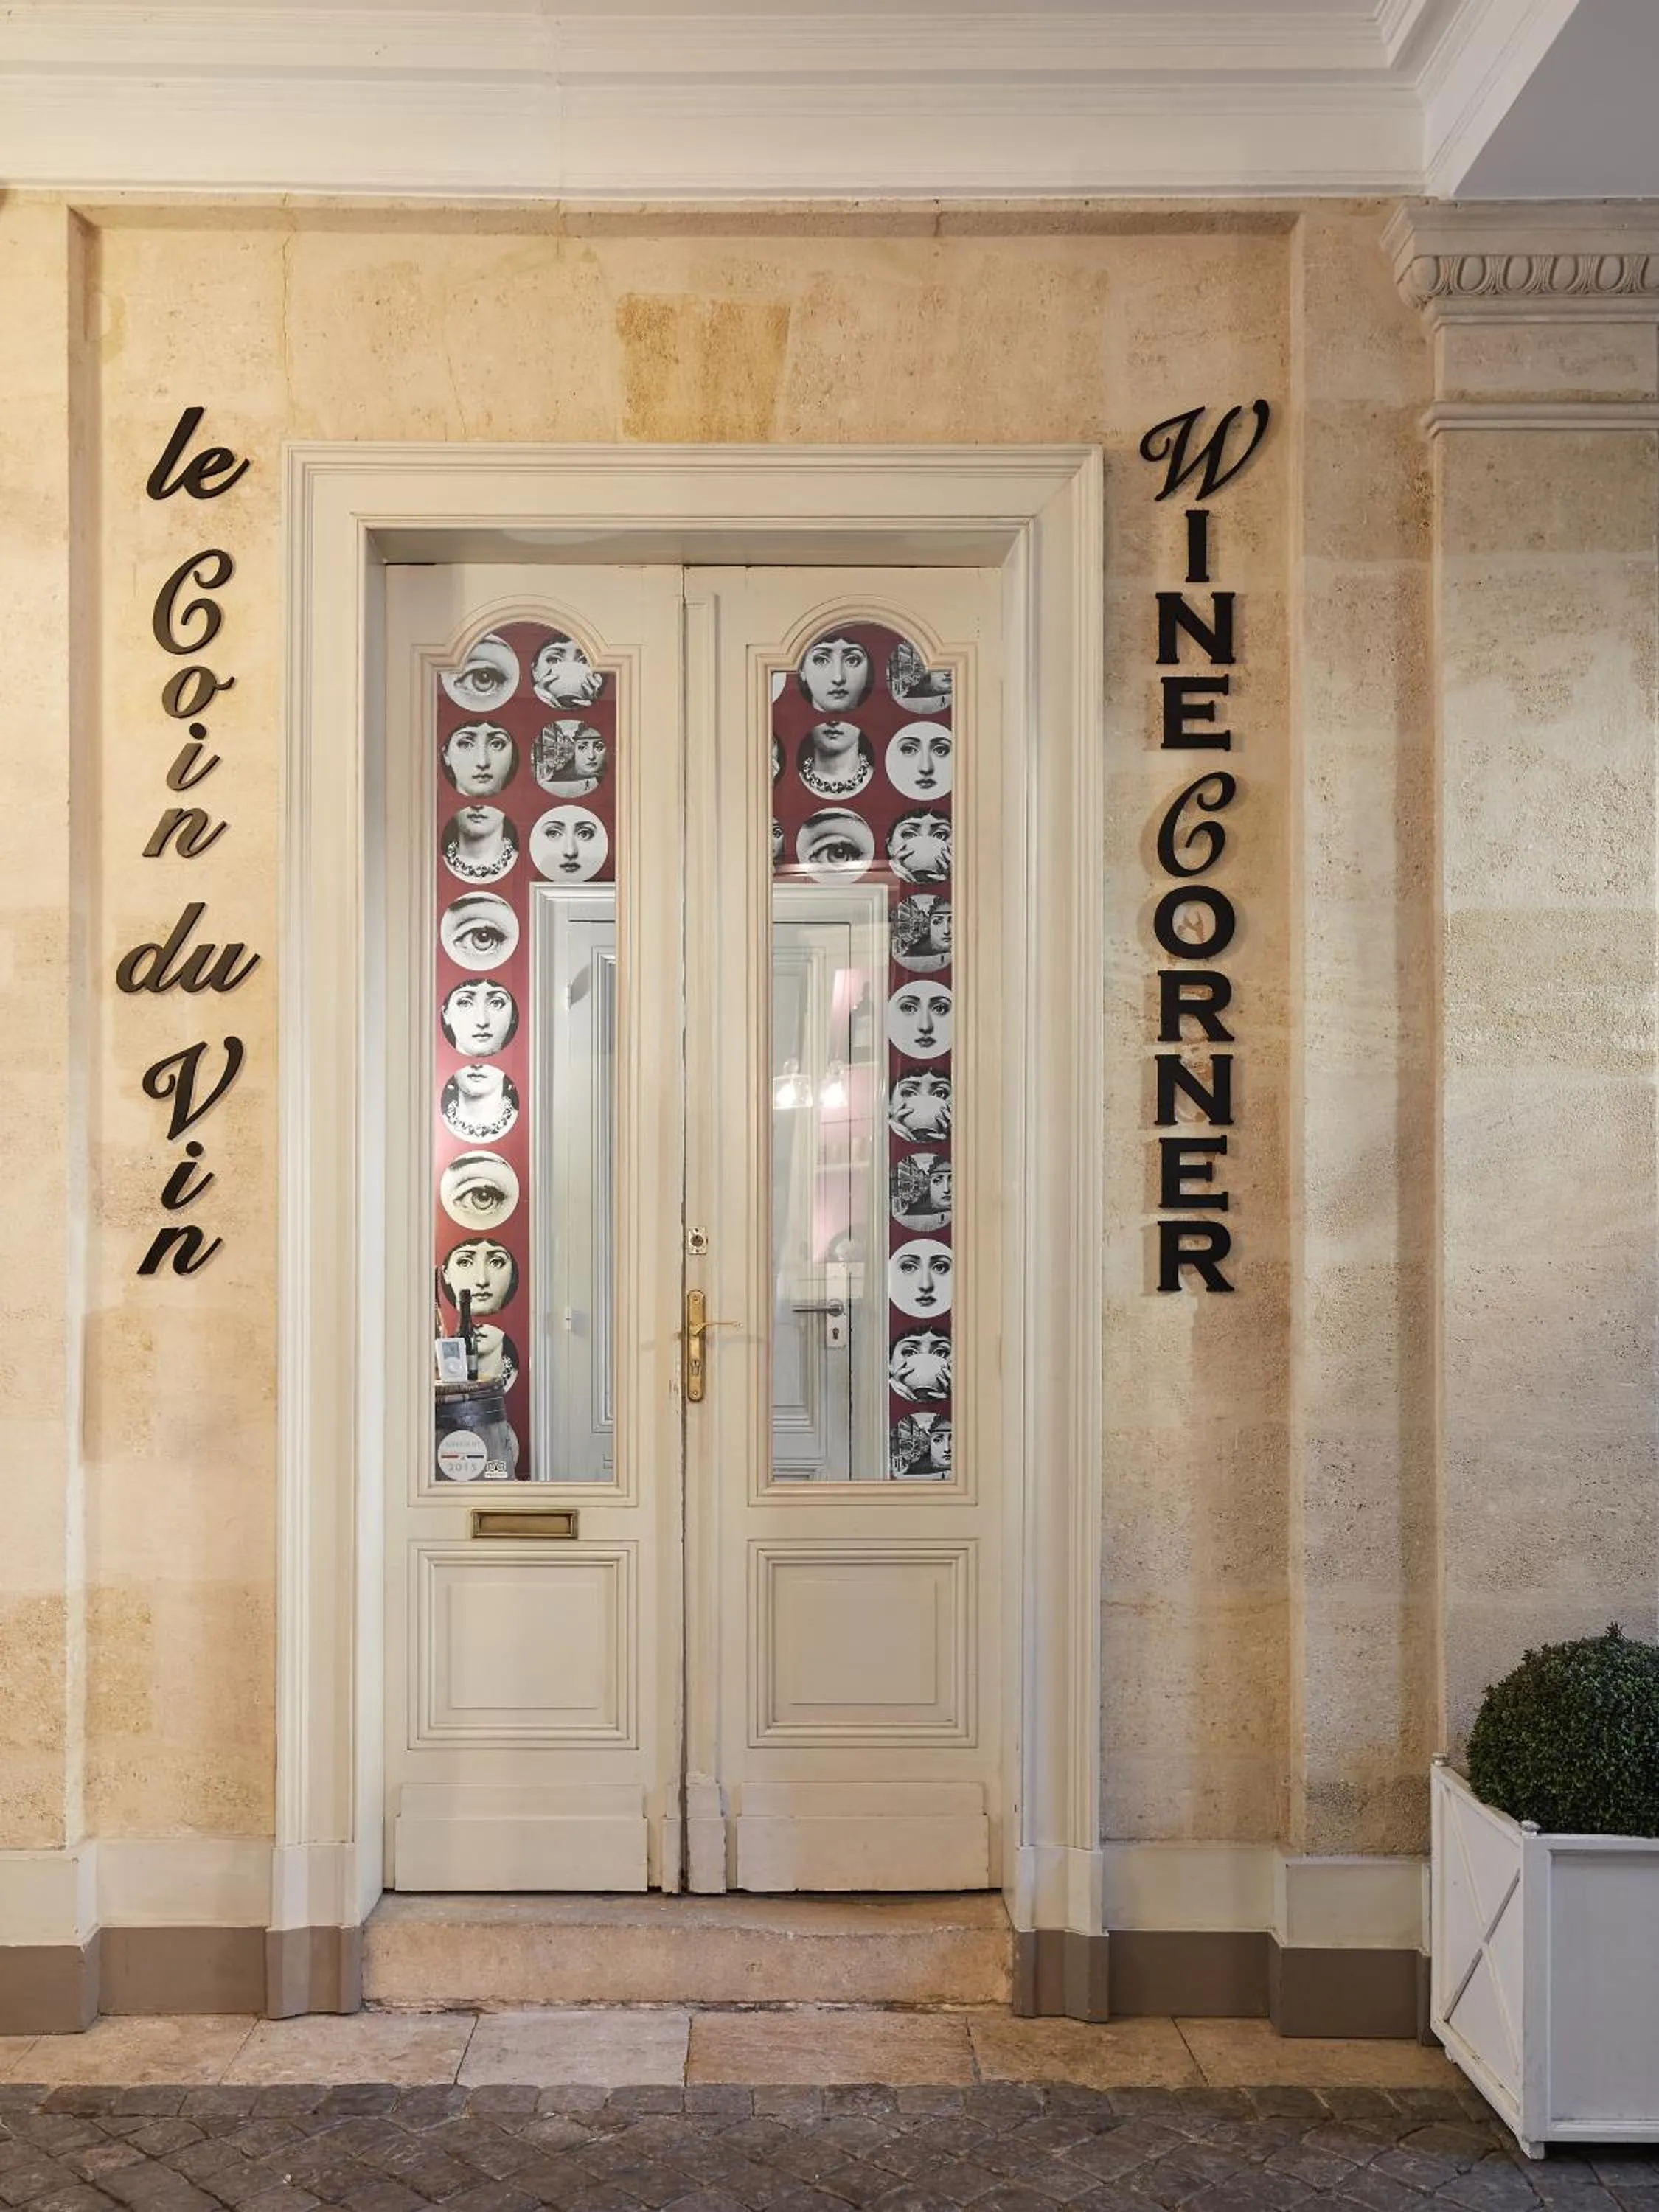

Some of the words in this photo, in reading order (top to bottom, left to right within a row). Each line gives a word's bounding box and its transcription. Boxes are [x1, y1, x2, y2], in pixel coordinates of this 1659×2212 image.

[146, 406, 250, 500] le
[1140, 399, 1270, 751] WINE
[142, 549, 234, 858] Coin
[116, 902, 260, 993] du
[1153, 771, 1236, 1292] CORNER
[137, 1036, 243, 1276] Vin
